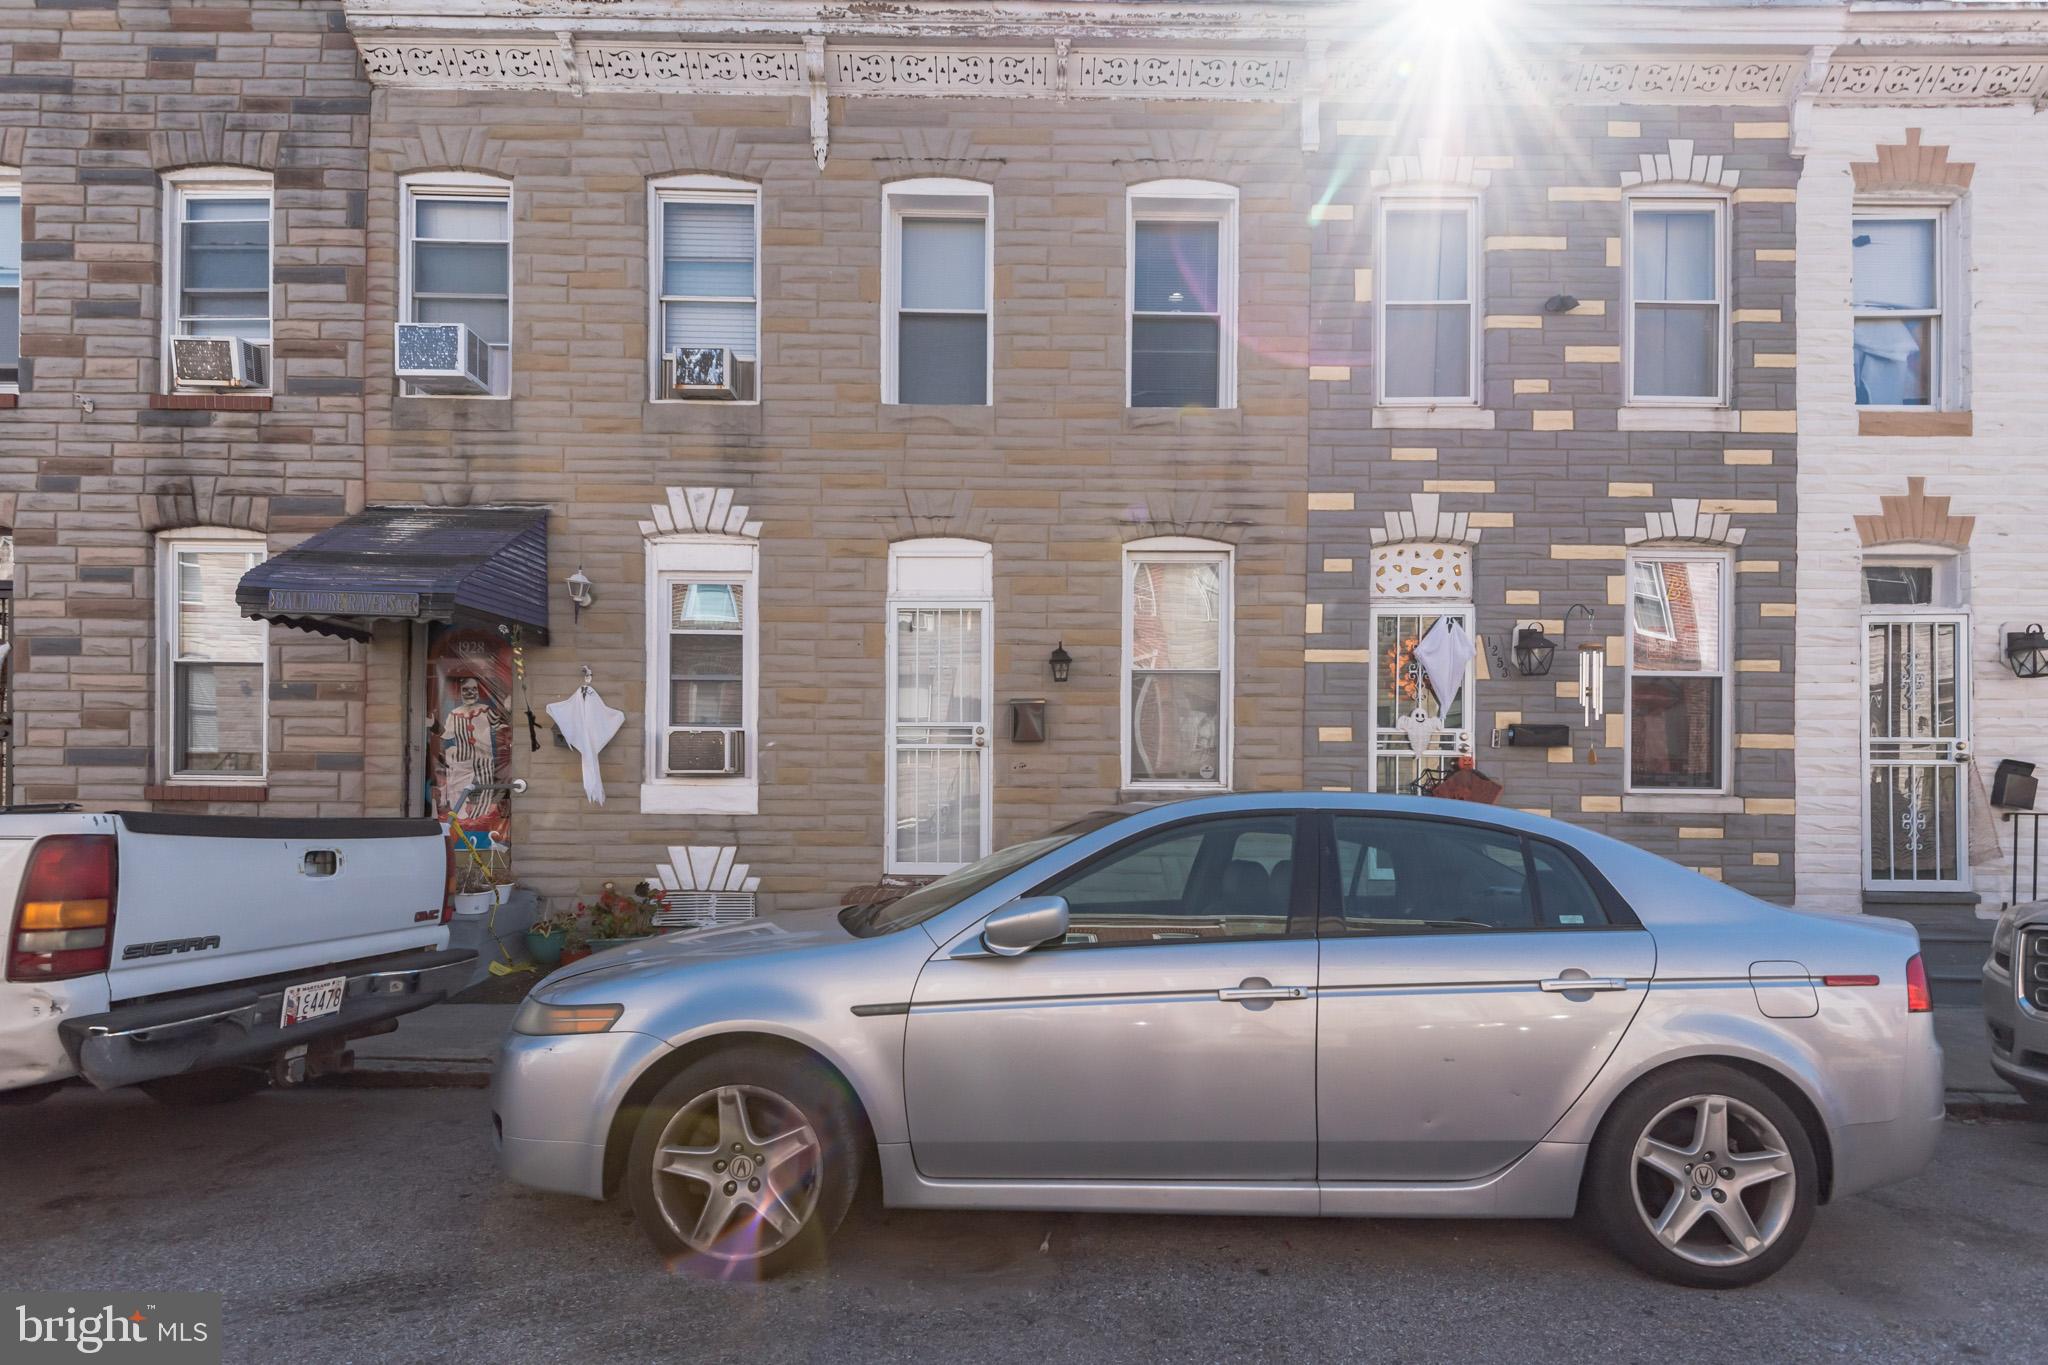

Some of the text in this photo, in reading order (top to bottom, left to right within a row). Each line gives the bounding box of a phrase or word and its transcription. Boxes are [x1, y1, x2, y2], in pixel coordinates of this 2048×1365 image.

[275, 591, 344, 611] BALTIMORE
[349, 592, 395, 611] RAVENS
[458, 641, 485, 654] 1928
[1487, 636, 1509, 679] 1253
[414, 909, 440, 922] GMC
[122, 935, 220, 960] SIERRA
[302, 982, 331, 991] MARYLAND
